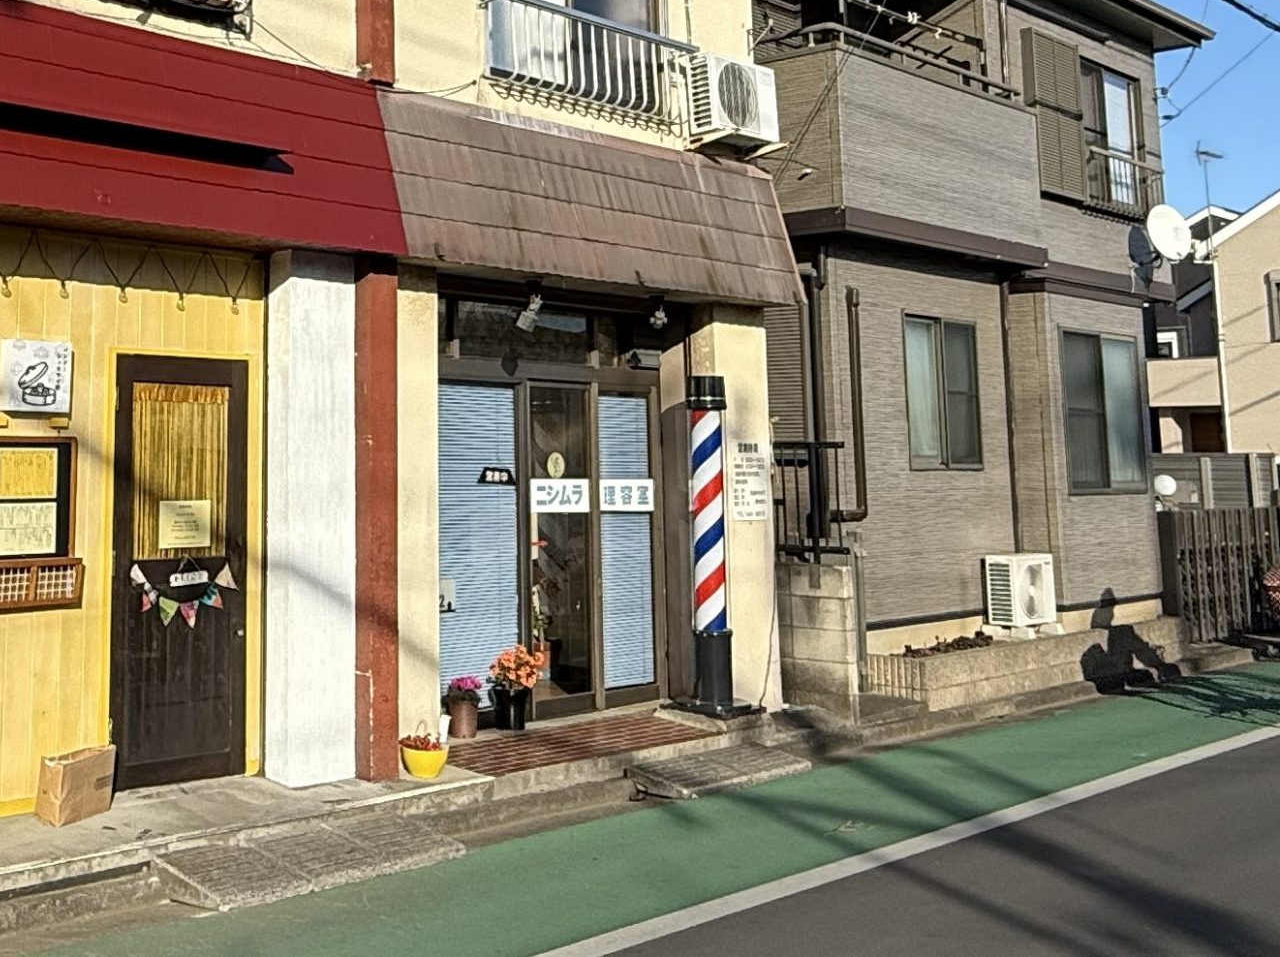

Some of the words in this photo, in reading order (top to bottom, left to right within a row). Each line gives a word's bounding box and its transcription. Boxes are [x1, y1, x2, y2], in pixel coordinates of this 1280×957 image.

[536, 484, 583, 506] ニシムラ
[603, 485, 650, 506] 理容室
